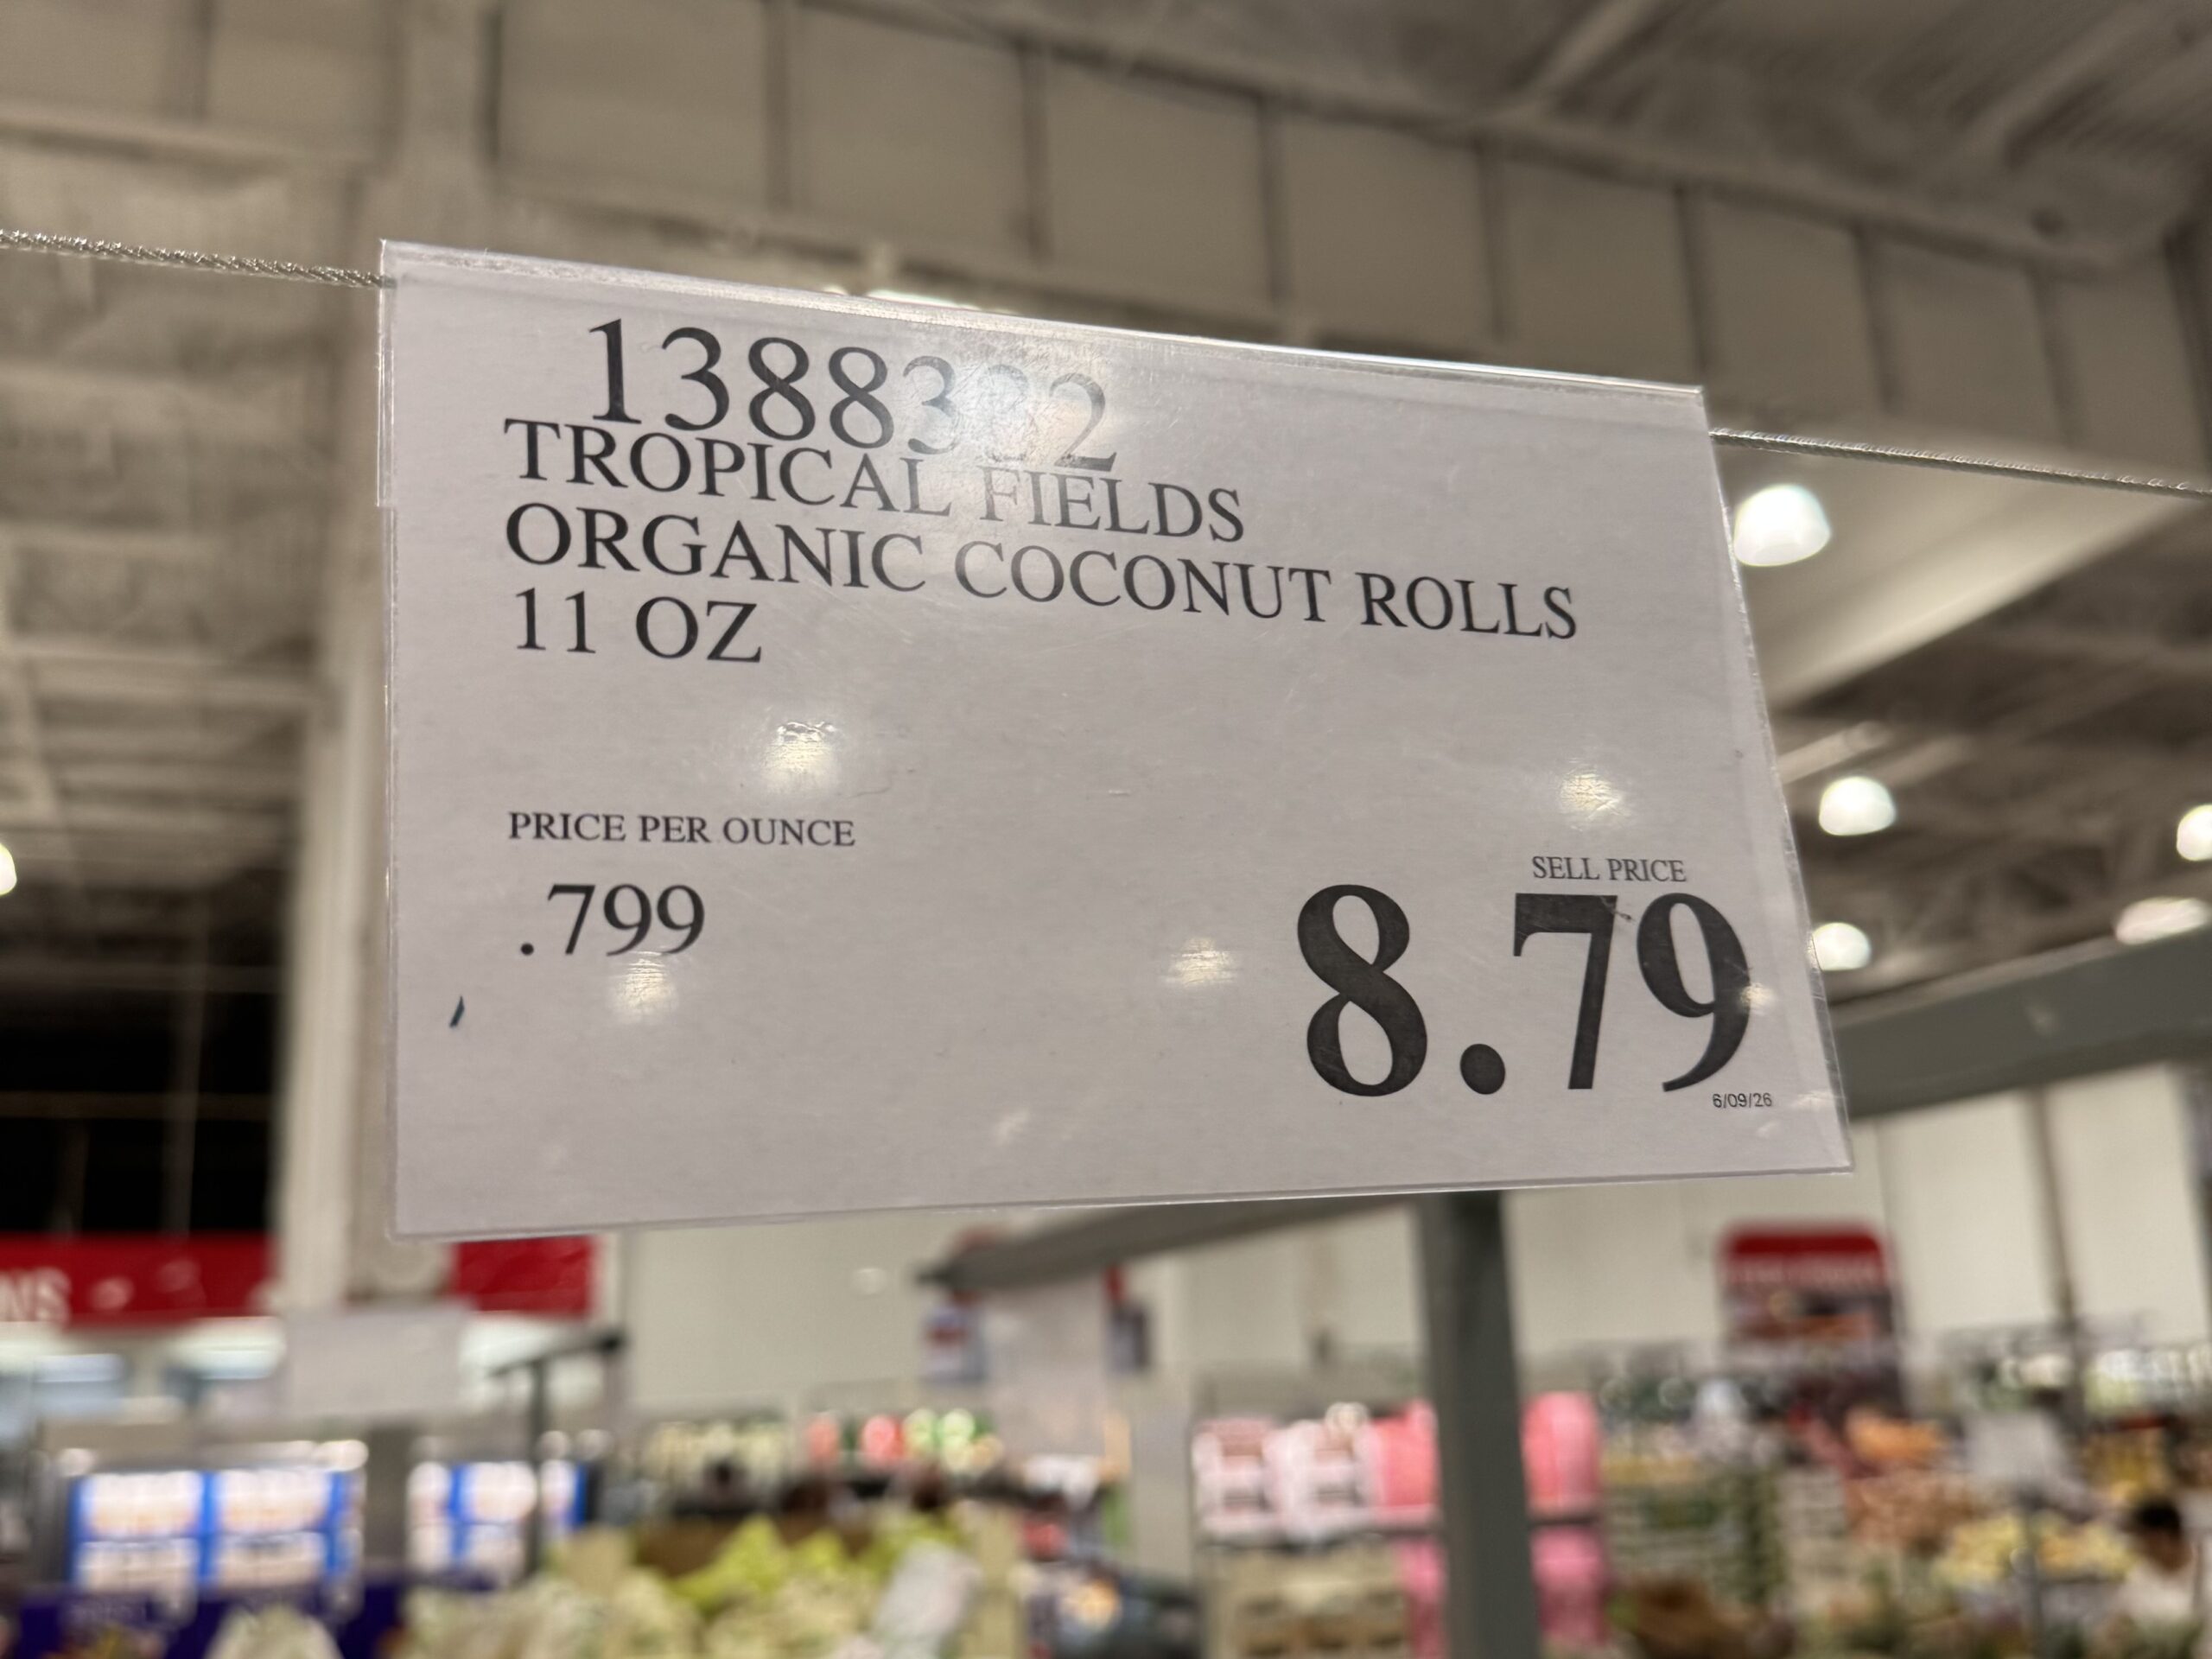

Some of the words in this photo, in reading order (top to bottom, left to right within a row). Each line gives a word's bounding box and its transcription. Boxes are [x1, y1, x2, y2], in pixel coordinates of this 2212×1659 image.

[504, 418, 950, 518] TROPICAL
[978, 466, 1244, 543] FIELDS
[505, 501, 926, 593] ORGANIC
[954, 540, 1332, 622] COCONUT
[1356, 570, 1577, 640] ROLLS
[514, 588, 596, 653] 11
[634, 594, 764, 664] OZ
[508, 811, 626, 842] PRICE
[638, 814, 711, 843] PER
[722, 817, 856, 847] OUNCE
[1532, 855, 1600, 881] SELL
[1607, 857, 1687, 882] PRICE
[520, 884, 705, 957] .799
[1297, 884, 1751, 1097] 8.79
[1713, 1092, 1772, 1108] 6/09/26
